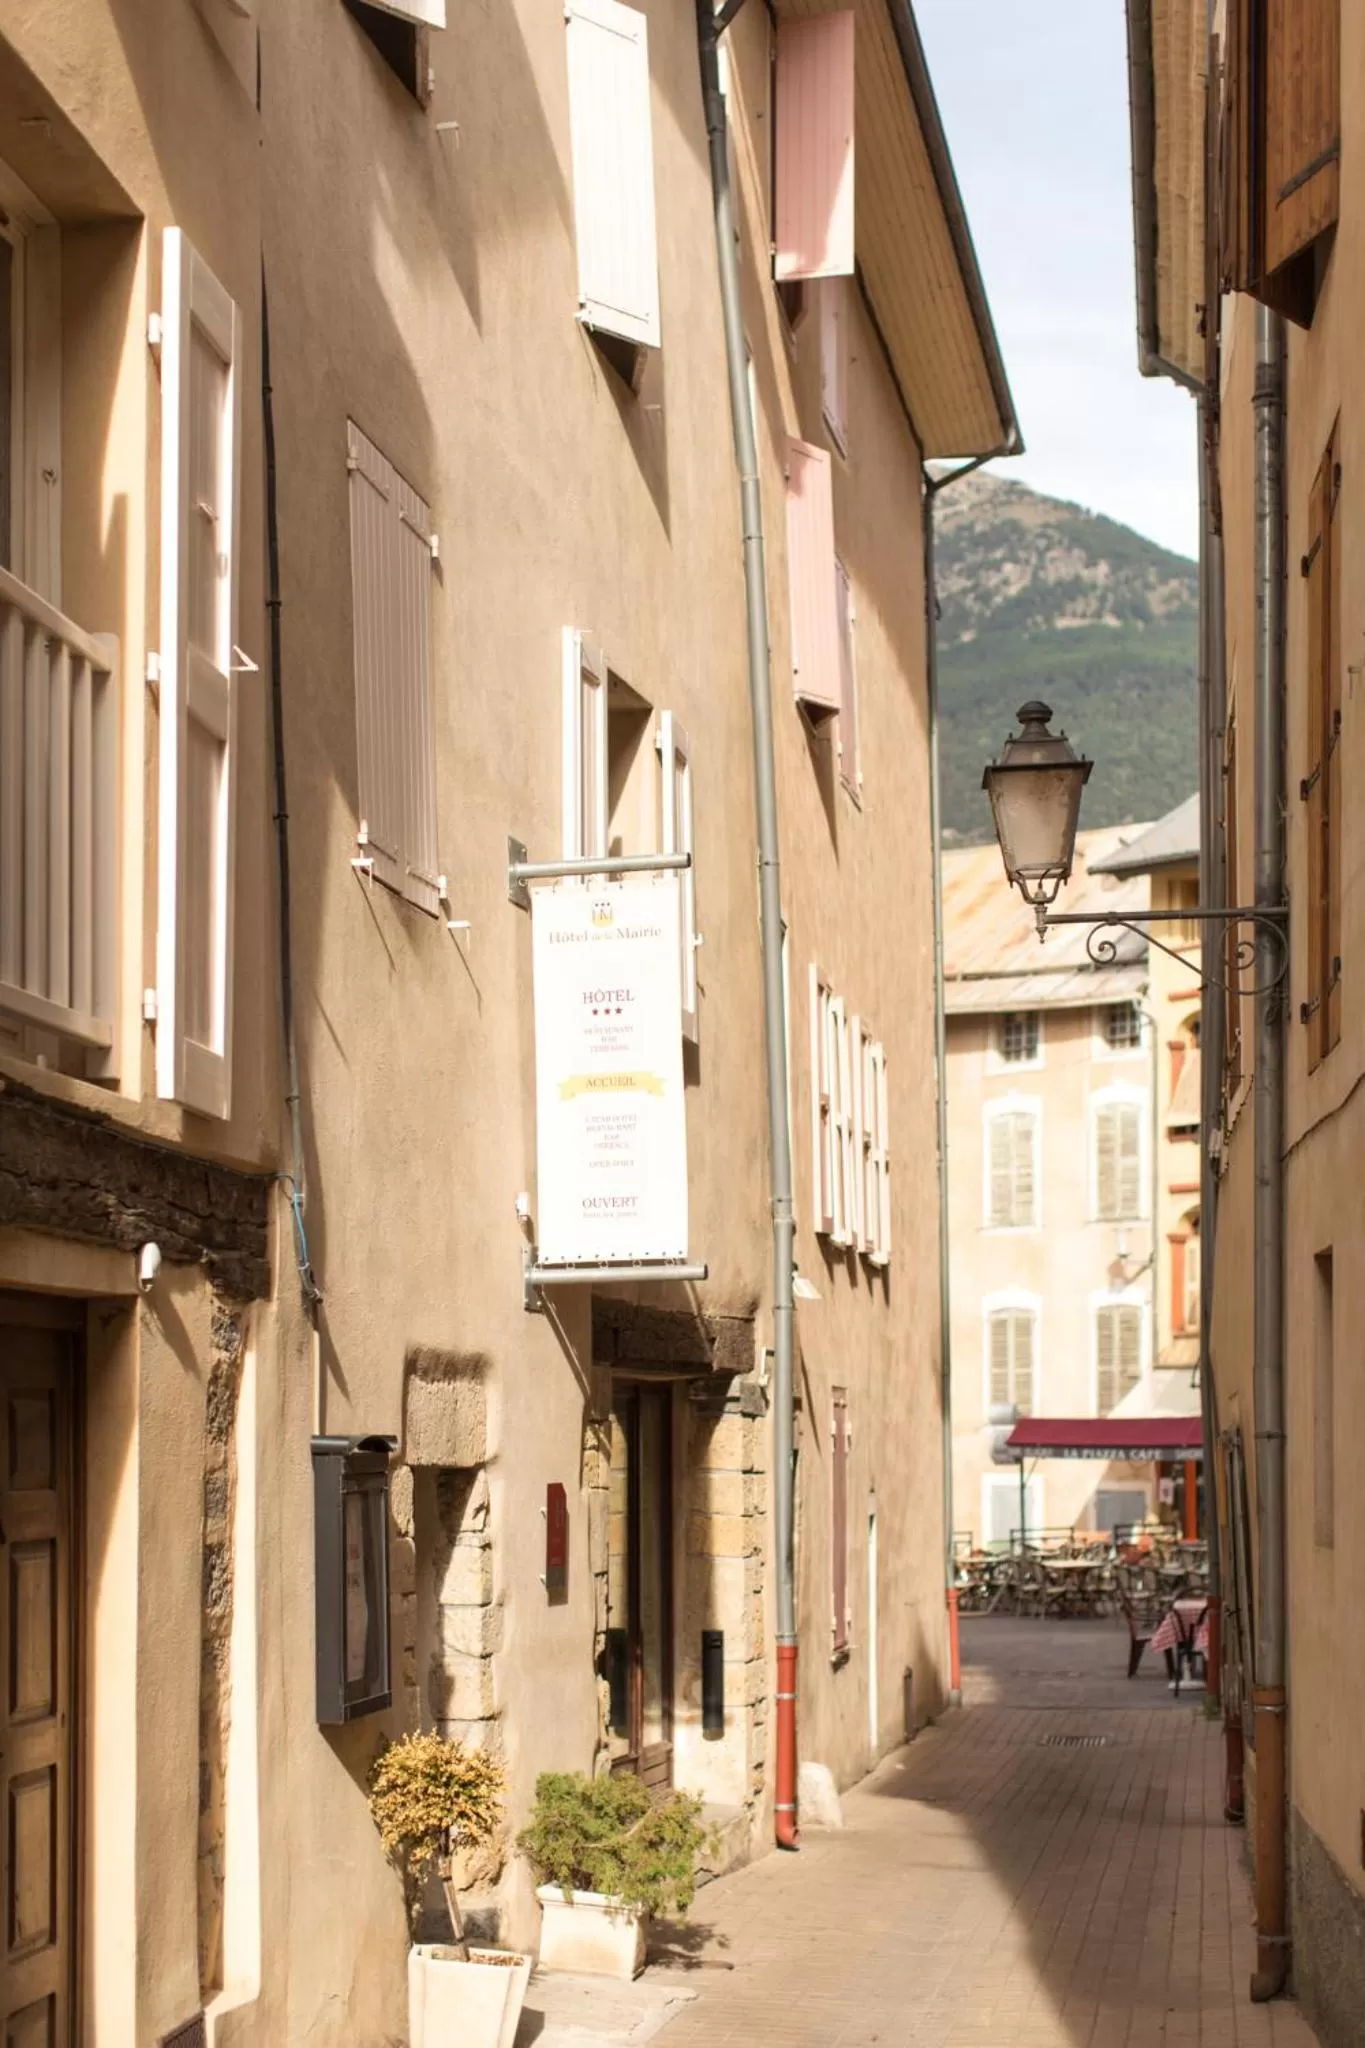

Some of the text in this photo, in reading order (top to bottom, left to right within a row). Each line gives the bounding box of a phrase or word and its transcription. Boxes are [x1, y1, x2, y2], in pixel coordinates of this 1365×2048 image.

[549, 930, 588, 944] Hôtel
[616, 926, 662, 940] Mairie
[582, 988, 635, 1004] HÔTEL
[586, 1076, 636, 1088] ACCUEIL
[582, 1196, 639, 1209] OUVERT
[1083, 1449, 1125, 1459] PIAZZA
